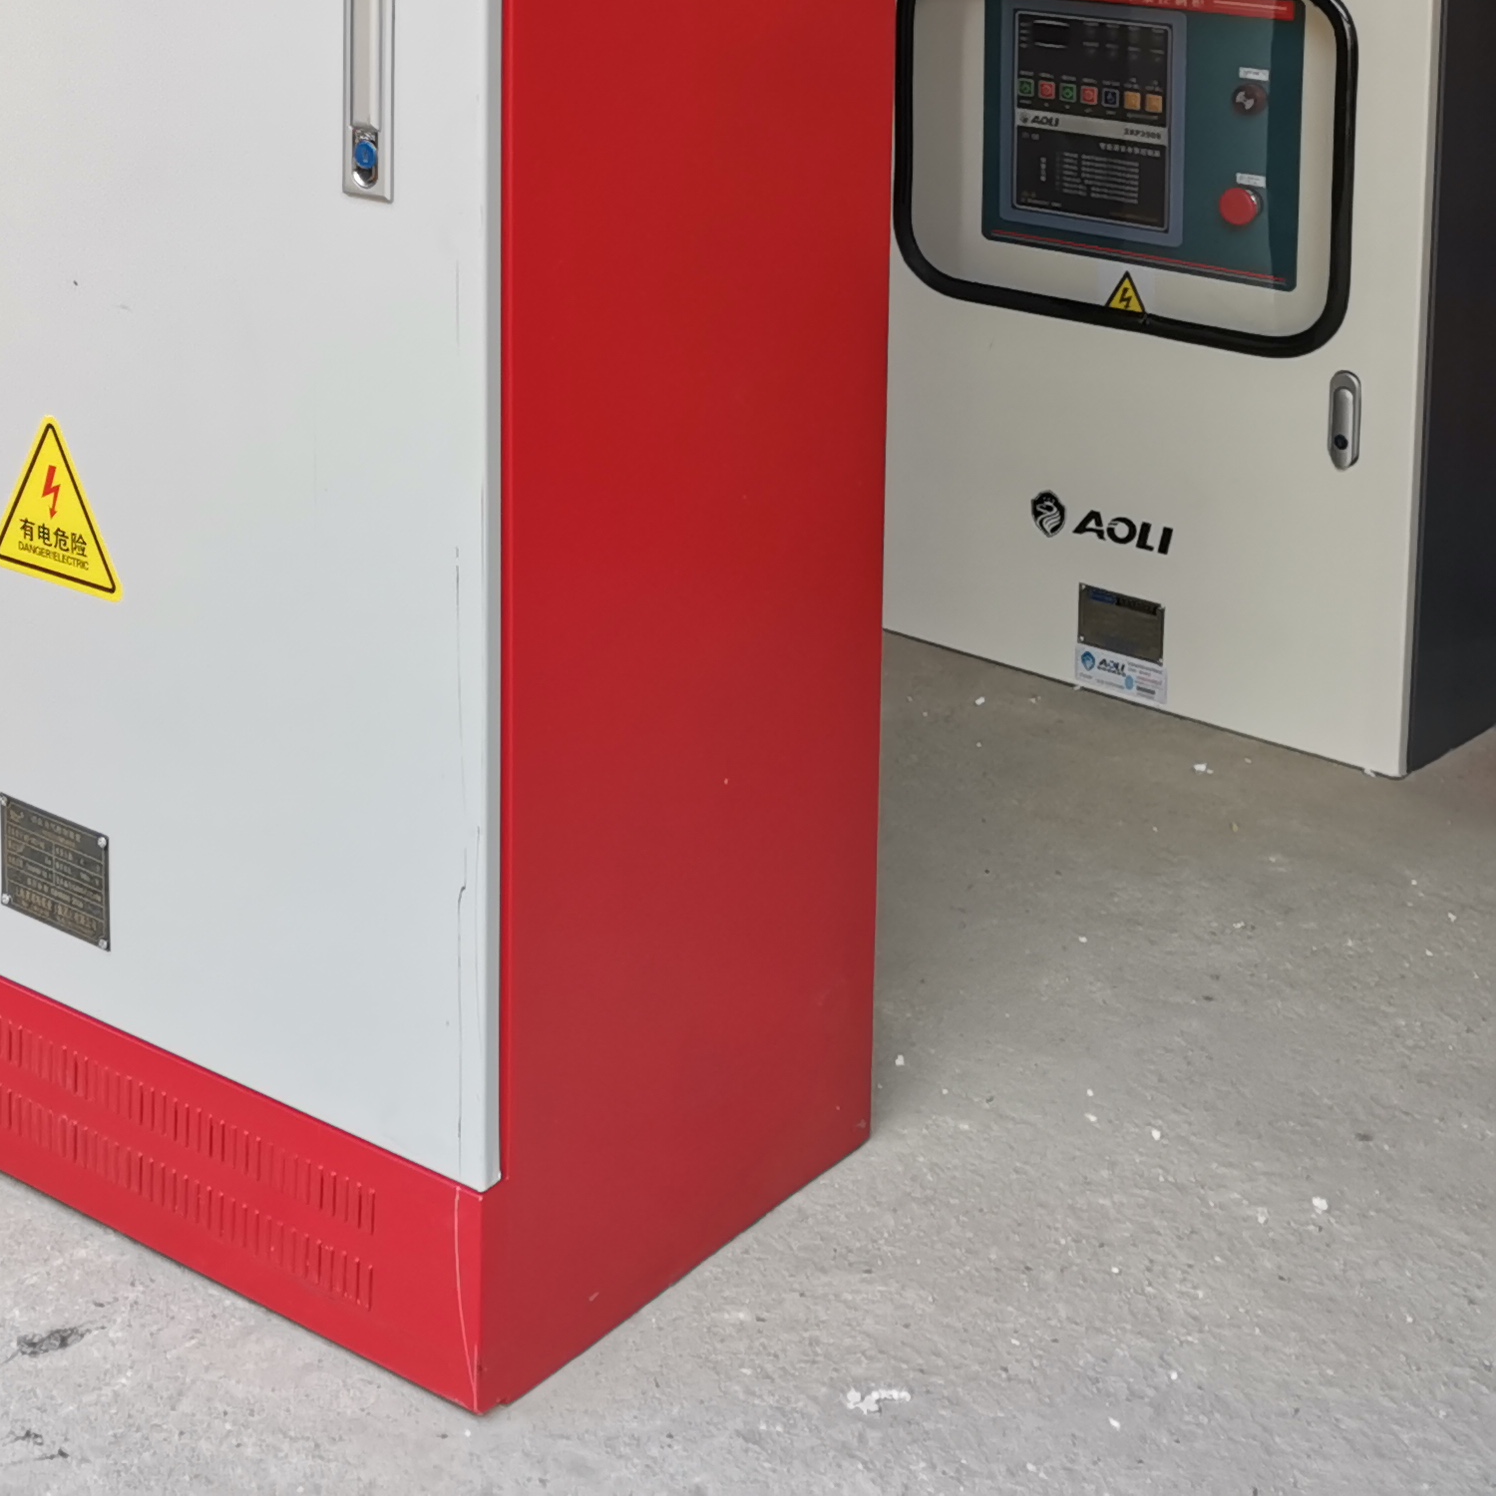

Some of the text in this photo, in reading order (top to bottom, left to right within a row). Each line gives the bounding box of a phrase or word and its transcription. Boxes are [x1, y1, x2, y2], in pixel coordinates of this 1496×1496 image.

[19, 517, 87, 557] 有电危险
[1072, 510, 1173, 555] AOLI
